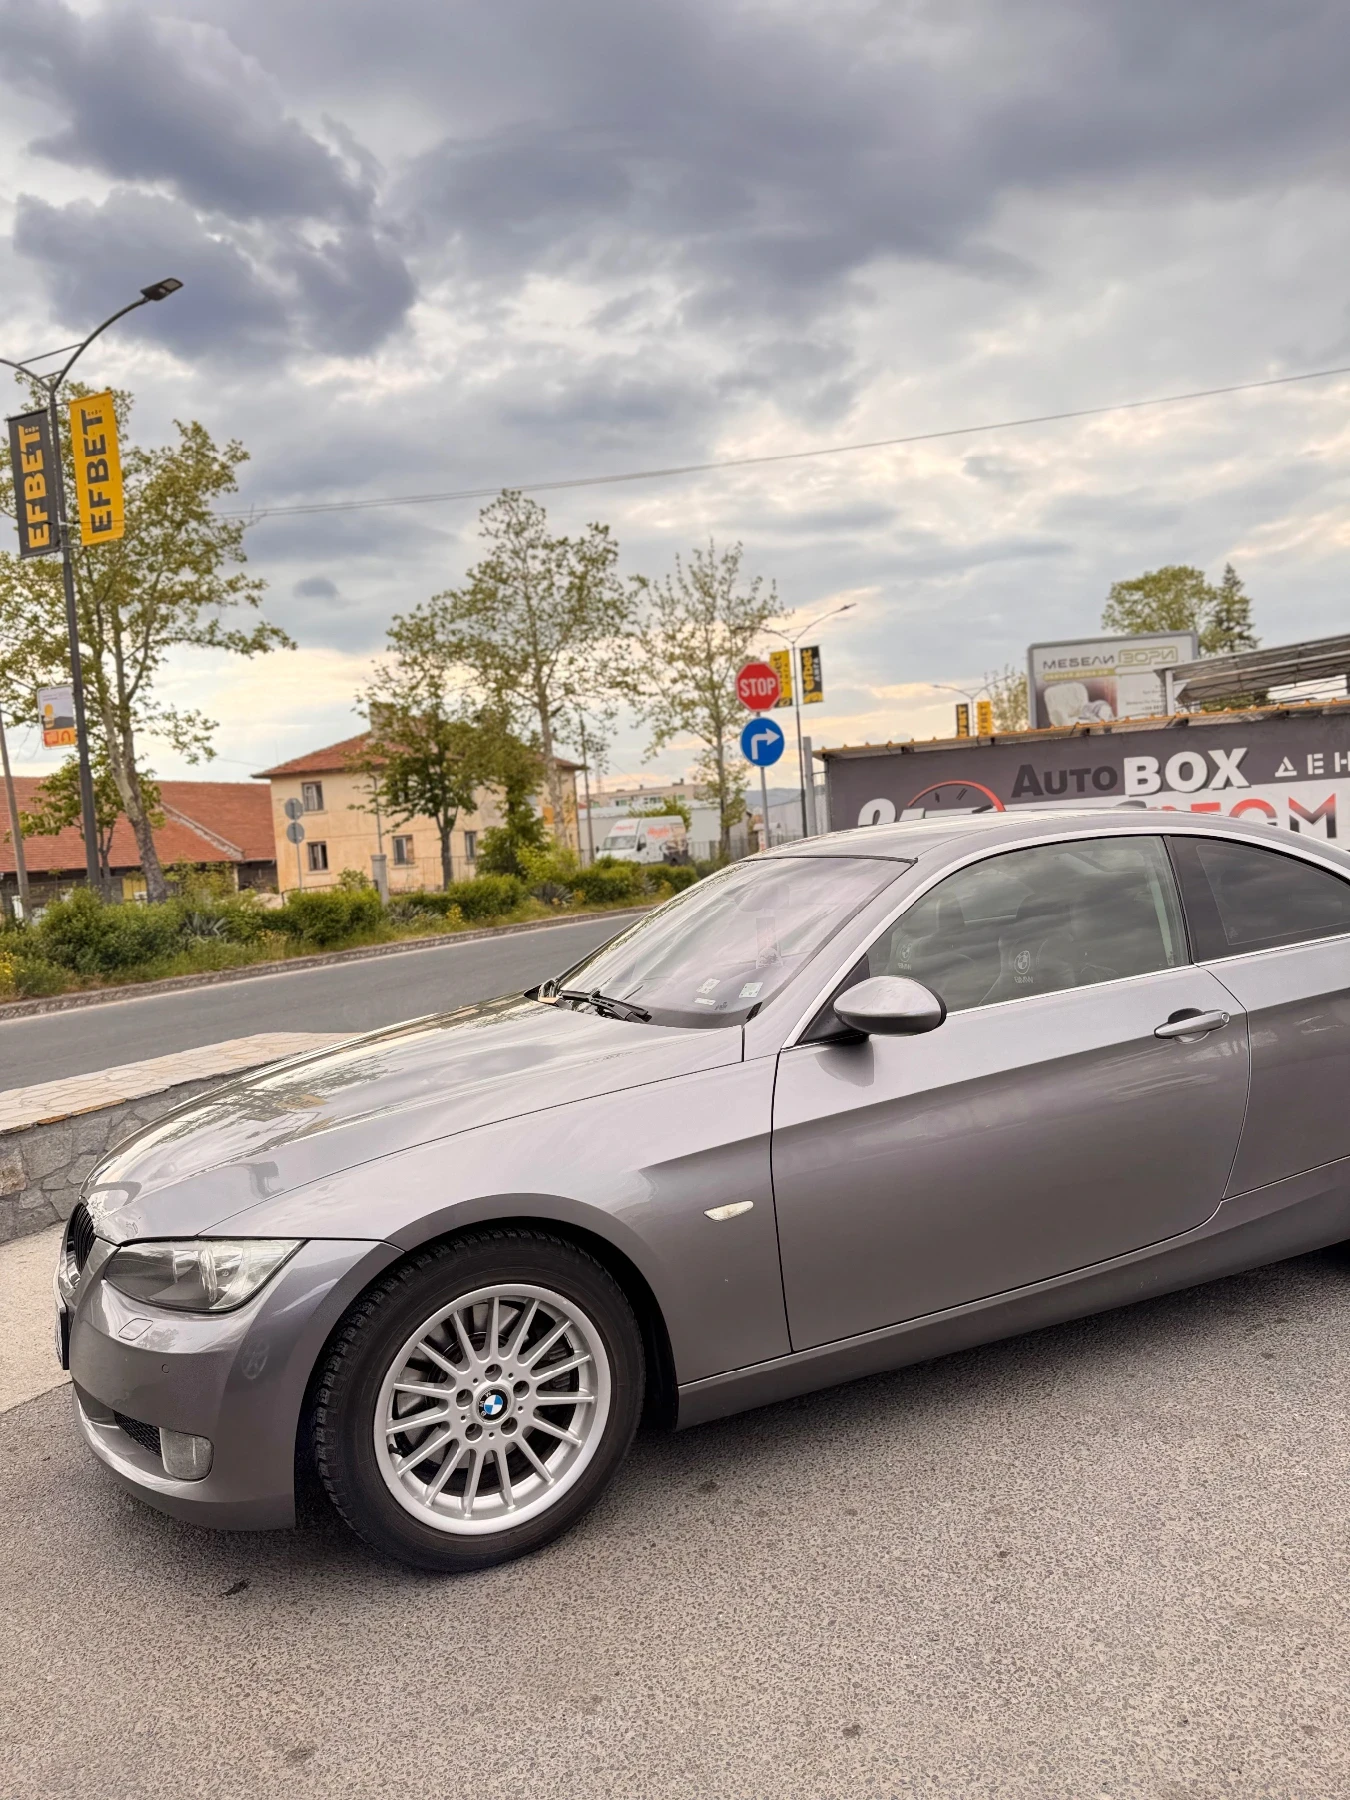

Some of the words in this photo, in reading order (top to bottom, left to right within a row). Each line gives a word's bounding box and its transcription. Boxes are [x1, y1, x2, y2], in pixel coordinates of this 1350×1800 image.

[81, 409, 112, 534] EFBET
[18, 425, 50, 548] EFBET
[1043, 654, 1114, 670] МЕБЕЛИ
[1122, 649, 1174, 664] ЗОРИ
[740, 677, 776, 697] STOP
[479, 1391, 492, 1416] BMW
